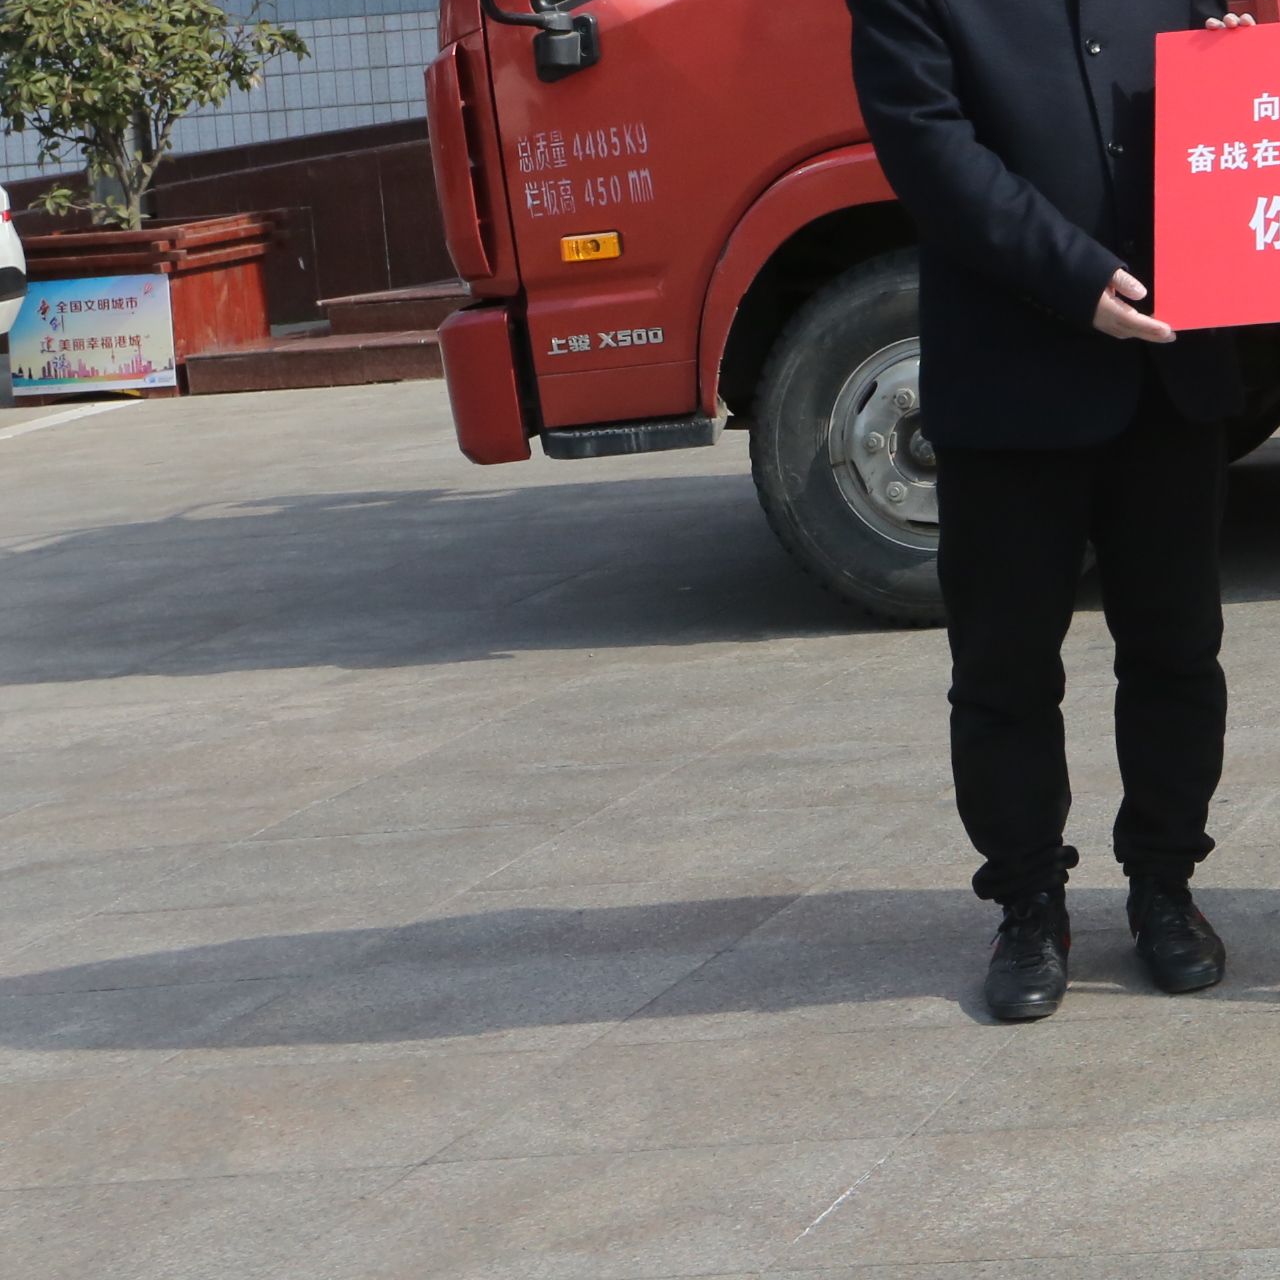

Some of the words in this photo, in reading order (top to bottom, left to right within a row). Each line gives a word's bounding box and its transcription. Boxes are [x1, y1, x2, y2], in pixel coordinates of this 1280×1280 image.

[518, 130, 568, 173] 总质量
[525, 178, 576, 218] 栏板高
[56, 296, 138, 314] 全国文明城市
[58, 334, 142, 352] 美丽幸福港城
[547, 335, 591, 355] 上骏
[598, 327, 664, 349] X500
